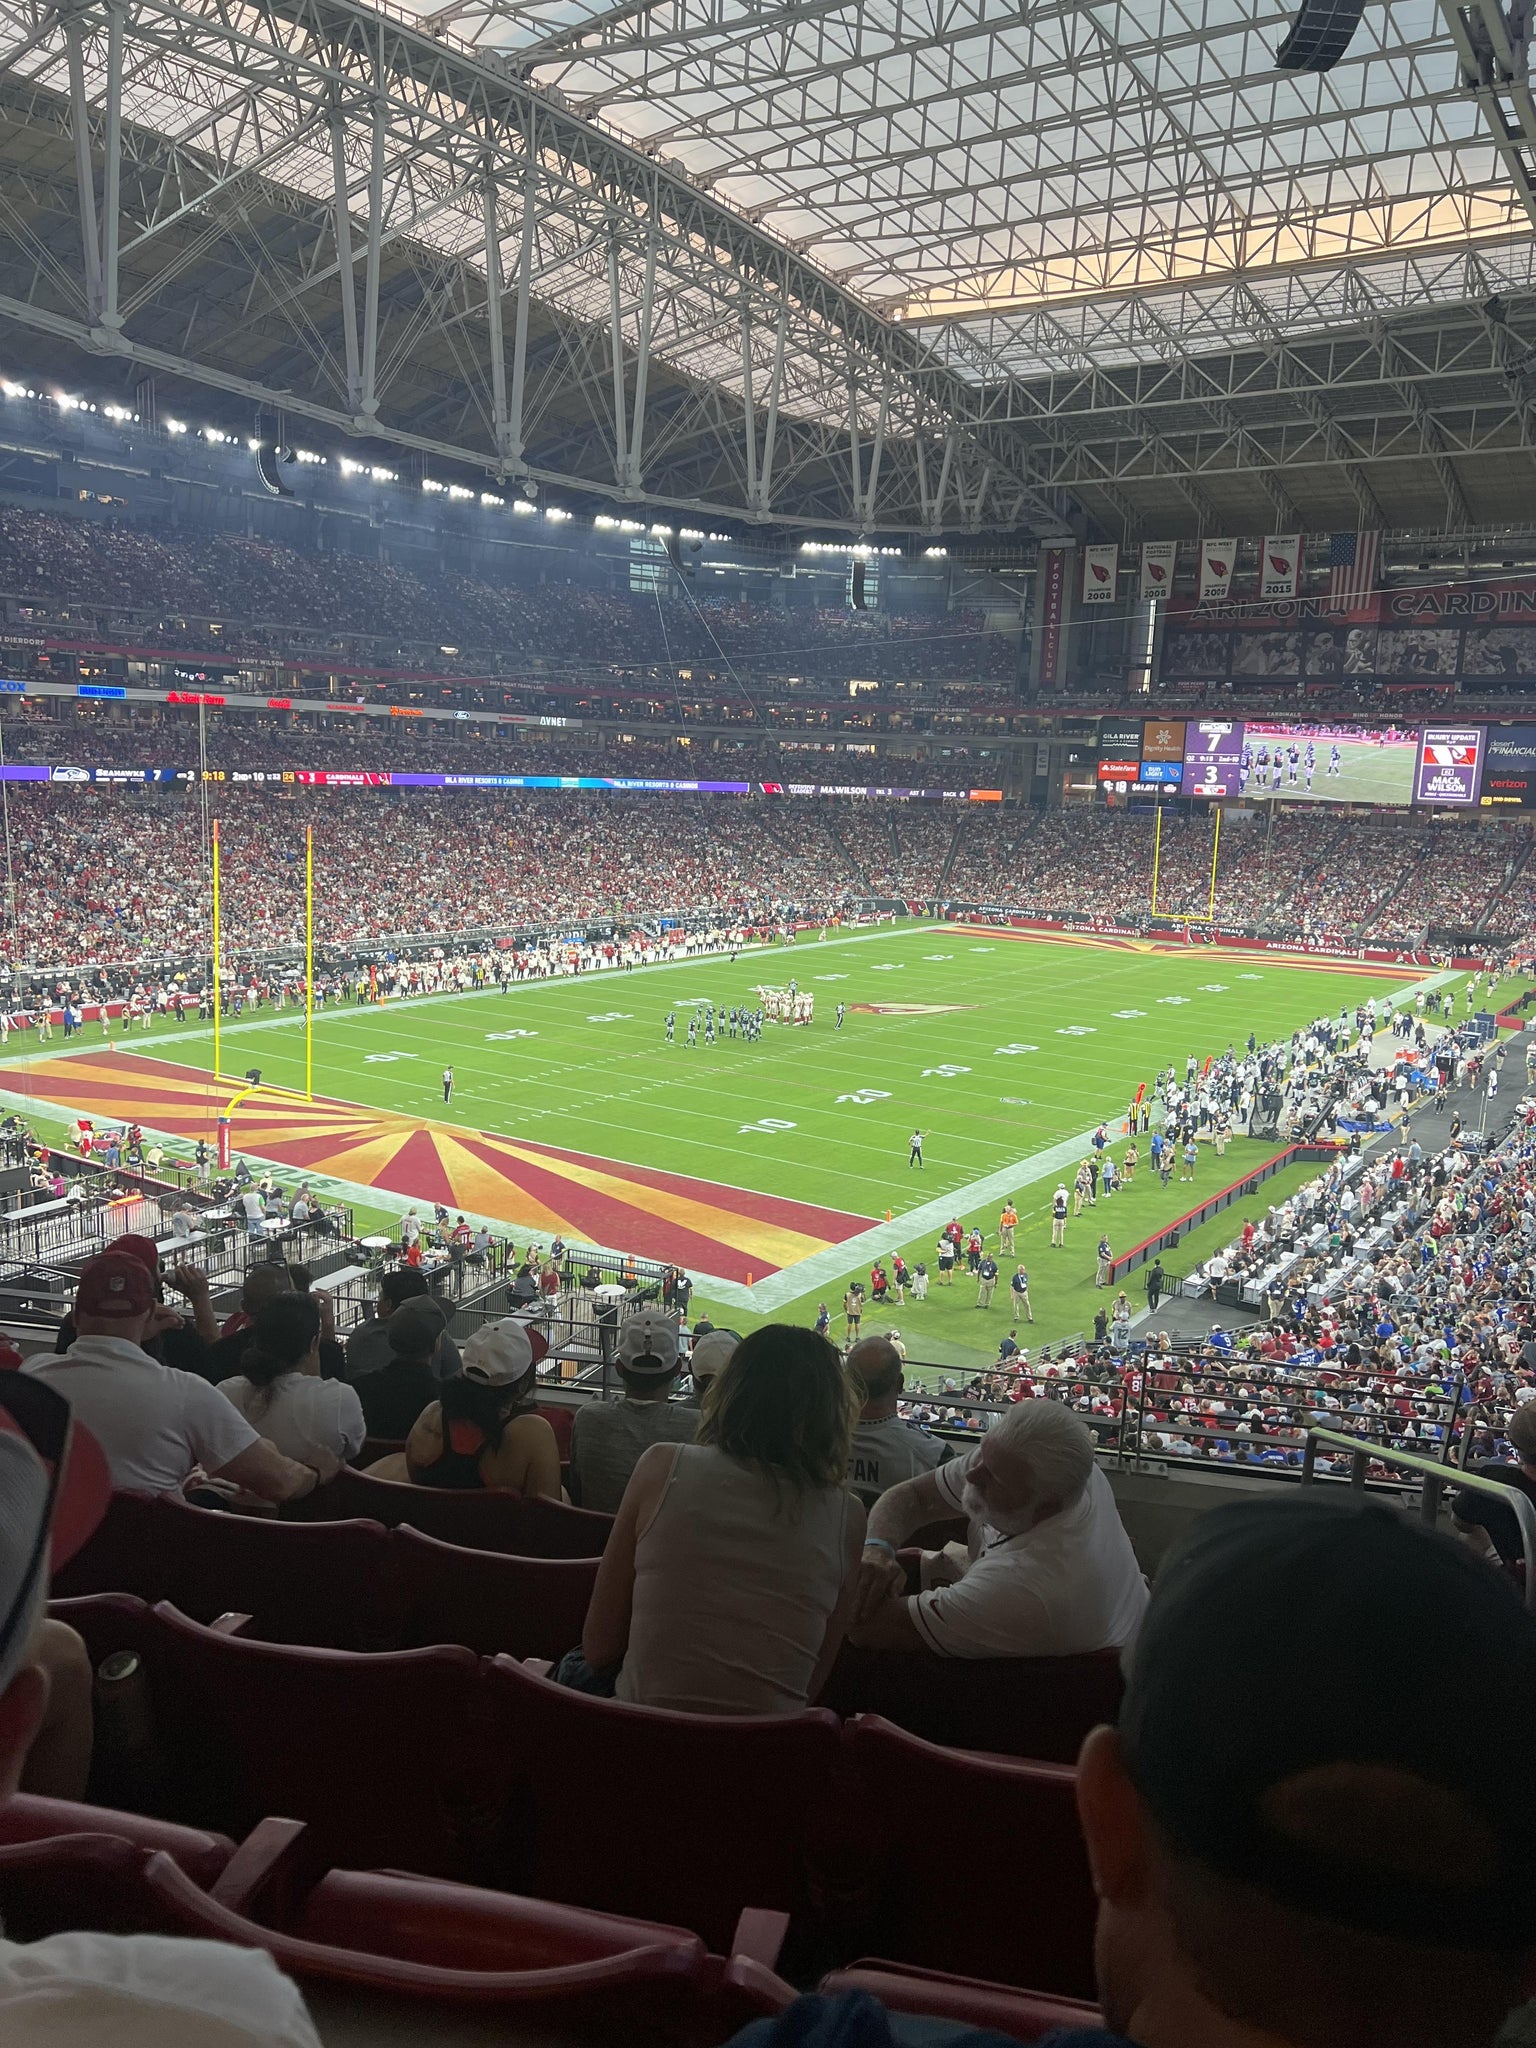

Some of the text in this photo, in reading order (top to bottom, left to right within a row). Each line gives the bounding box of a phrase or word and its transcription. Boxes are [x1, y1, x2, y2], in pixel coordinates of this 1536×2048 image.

[1144, 589, 1167, 599] 2008
[1204, 588, 1227, 597] 2009
[1265, 585, 1292, 594] 2015
[1049, 563, 1060, 640] FOOTBALL
[1087, 592, 1112, 600] 2008
[4, 635, 46, 647] DIERDORF
[237, 657, 285, 667] LARRY WILSON
[0, 681, 26, 692] COX
[539, 716, 567, 727] AVNET
[1208, 733, 1222, 752] 7
[1145, 745, 1163, 753] Dignity
[95, 769, 146, 777] SEAHAWKS
[153, 769, 161, 781] 7
[187, 771, 195, 781] 2
[203, 771, 226, 781] 9:18
[253, 772, 265, 781] 10
[284, 773, 294, 781] 24
[309, 772, 316, 783] 3
[1204, 765, 1218, 784] 3
[475, 777, 498, 785] RESORTS
[1432, 776, 1461, 785] MACK
[1490, 779, 1529, 789] verizon
[820, 785, 867, 795] MA.WILSON
[1103, 780, 1128, 794] 9:18
[1426, 783, 1466, 793] WILSON
[1062, 923, 1136, 936] AIZONA CARDINAL
[1171, 923, 1203, 931] ARIONA
[1265, 942, 1358, 957] ARIZONA CARDINALS
[1056, 1025, 1098, 1036] 50
[993, 1043, 1041, 1055] 40
[920, 1063, 973, 1078] 30
[835, 1088, 893, 1105] 20
[738, 1118, 798, 1135] 10
[1117, 1328, 1129, 1340] 12
[1223, 1336, 1232, 1347] 9
